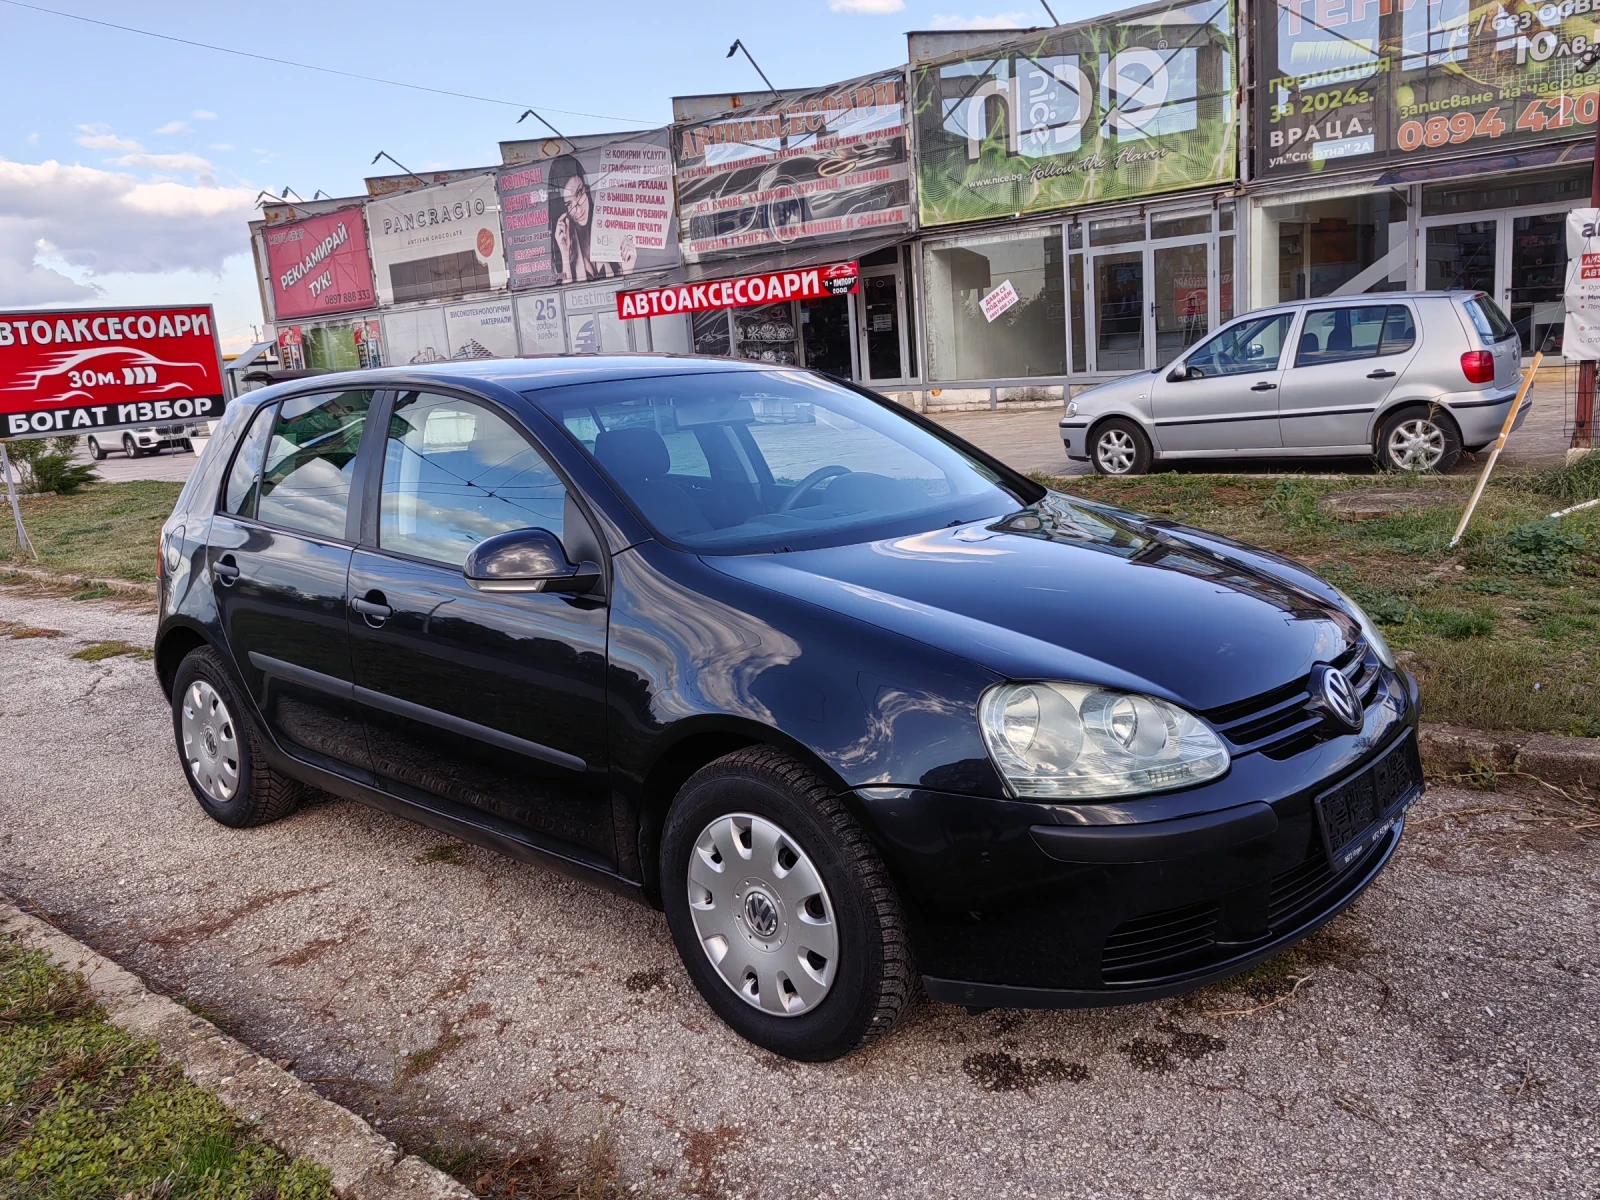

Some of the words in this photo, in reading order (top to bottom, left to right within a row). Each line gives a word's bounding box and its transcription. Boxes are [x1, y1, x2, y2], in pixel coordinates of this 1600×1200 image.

[1301, 87, 1375, 114] 2024г.
[1499, 87, 1522, 100] на
[680, 80, 898, 160] АВТОАКСЕСОАРИ
[1397, 106, 1506, 152] 0894
[1516, 91, 1599, 132] 420
[612, 149, 641, 160] КОПИРНИ
[642, 150, 666, 161] УСЛУГИ
[501, 167, 542, 191] КОПИРЕН
[968, 172, 1023, 189] www.nice.bg
[1078, 154, 1108, 172] the
[1113, 146, 1169, 169] Flavor
[637, 179, 668, 191] РЕКЛАМА
[503, 190, 538, 213] ЦЕНТЪР
[606, 192, 634, 203] ВЪНШНА
[635, 193, 666, 206] РЕКЛАМА
[383, 198, 485, 235] PANCRACIO
[506, 208, 549, 231] РЕКЛАМА
[602, 205, 635, 217] РЕКЛАМНИ
[636, 207, 668, 220] СУВЕНИРИ
[604, 218, 636, 231] ФИРМЕНИ
[637, 222, 662, 233] ПЕЧАТИ
[407, 236, 430, 246] ARTISAN
[431, 229, 463, 241] CHOCOLATE
[635, 235, 663, 247] ТЕНИСКИ
[280, 222, 348, 290] РЕКЛАМИРАЙ
[309, 270, 332, 298] ТУК!
[622, 270, 819, 317] АВТОАКСЕСОАРИ
[985, 291, 1000, 306] ДАВА
[999, 285, 1007, 294] СЕ
[324, 293, 341, 305] 0897
[343, 291, 357, 303] 888
[357, 289, 371, 301] 333
[985, 301, 998, 313] ПОД
[996, 290, 1013, 305] НАЕМ
[449, 304, 510, 319] ВИСОКОТЕХНОЛОГИЧНИ
[535, 297, 557, 321] 25
[480, 315, 512, 327] МАТЕРИАЛИ
[8, 405, 108, 434] БОГАТ
[118, 398, 212, 423] ИЗБОР
